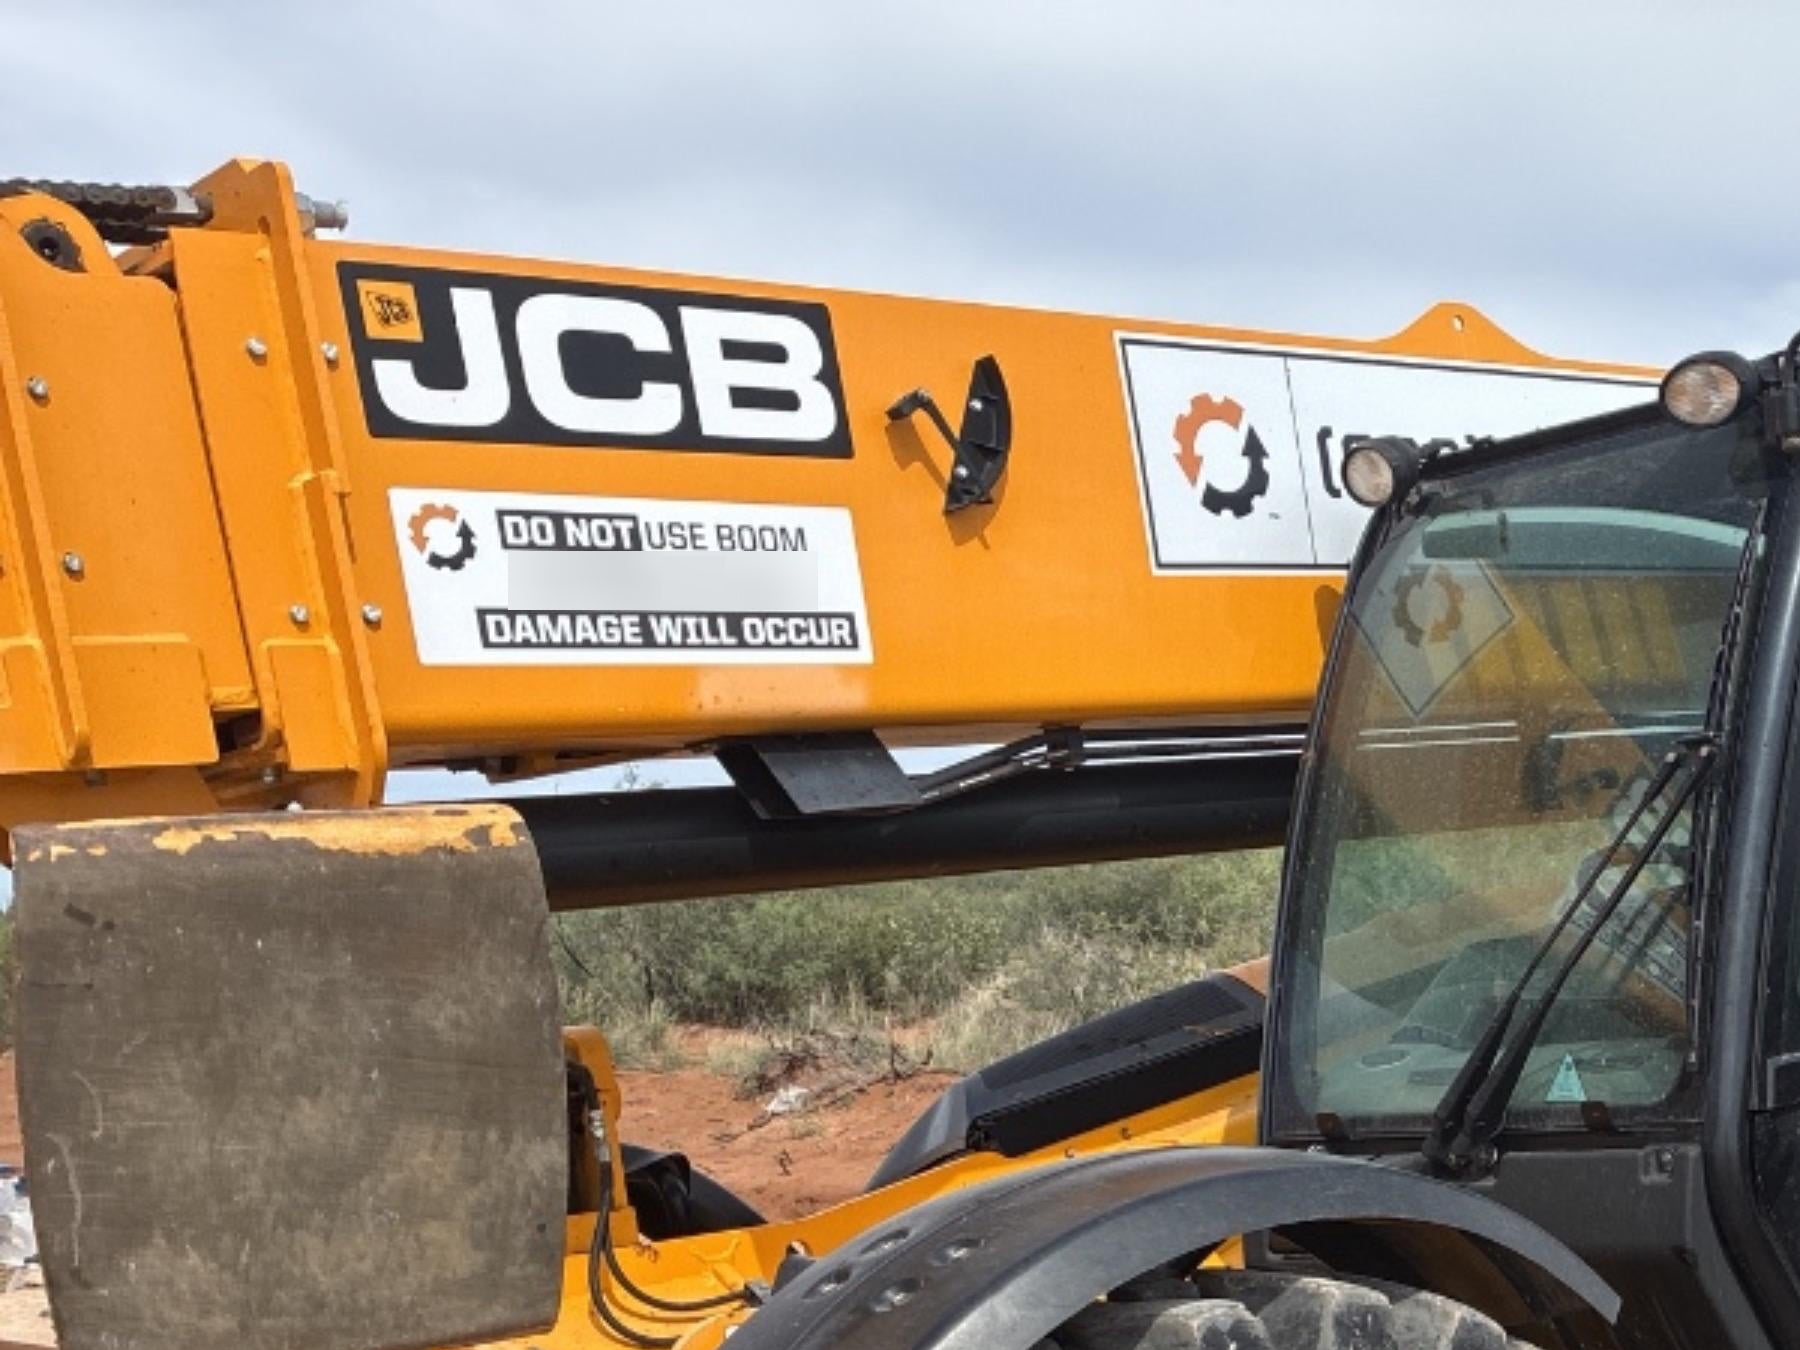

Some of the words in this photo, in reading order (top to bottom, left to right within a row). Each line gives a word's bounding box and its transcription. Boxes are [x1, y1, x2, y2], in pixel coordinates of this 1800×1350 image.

[372, 287, 839, 442] JCB
[502, 514, 556, 547] DO
[563, 518, 636, 550] NOT
[645, 521, 709, 551] USE
[715, 523, 809, 552] BOOM
[484, 614, 643, 645] DAMAGE
[648, 616, 738, 646] WILL
[741, 617, 854, 647] OCCUR
